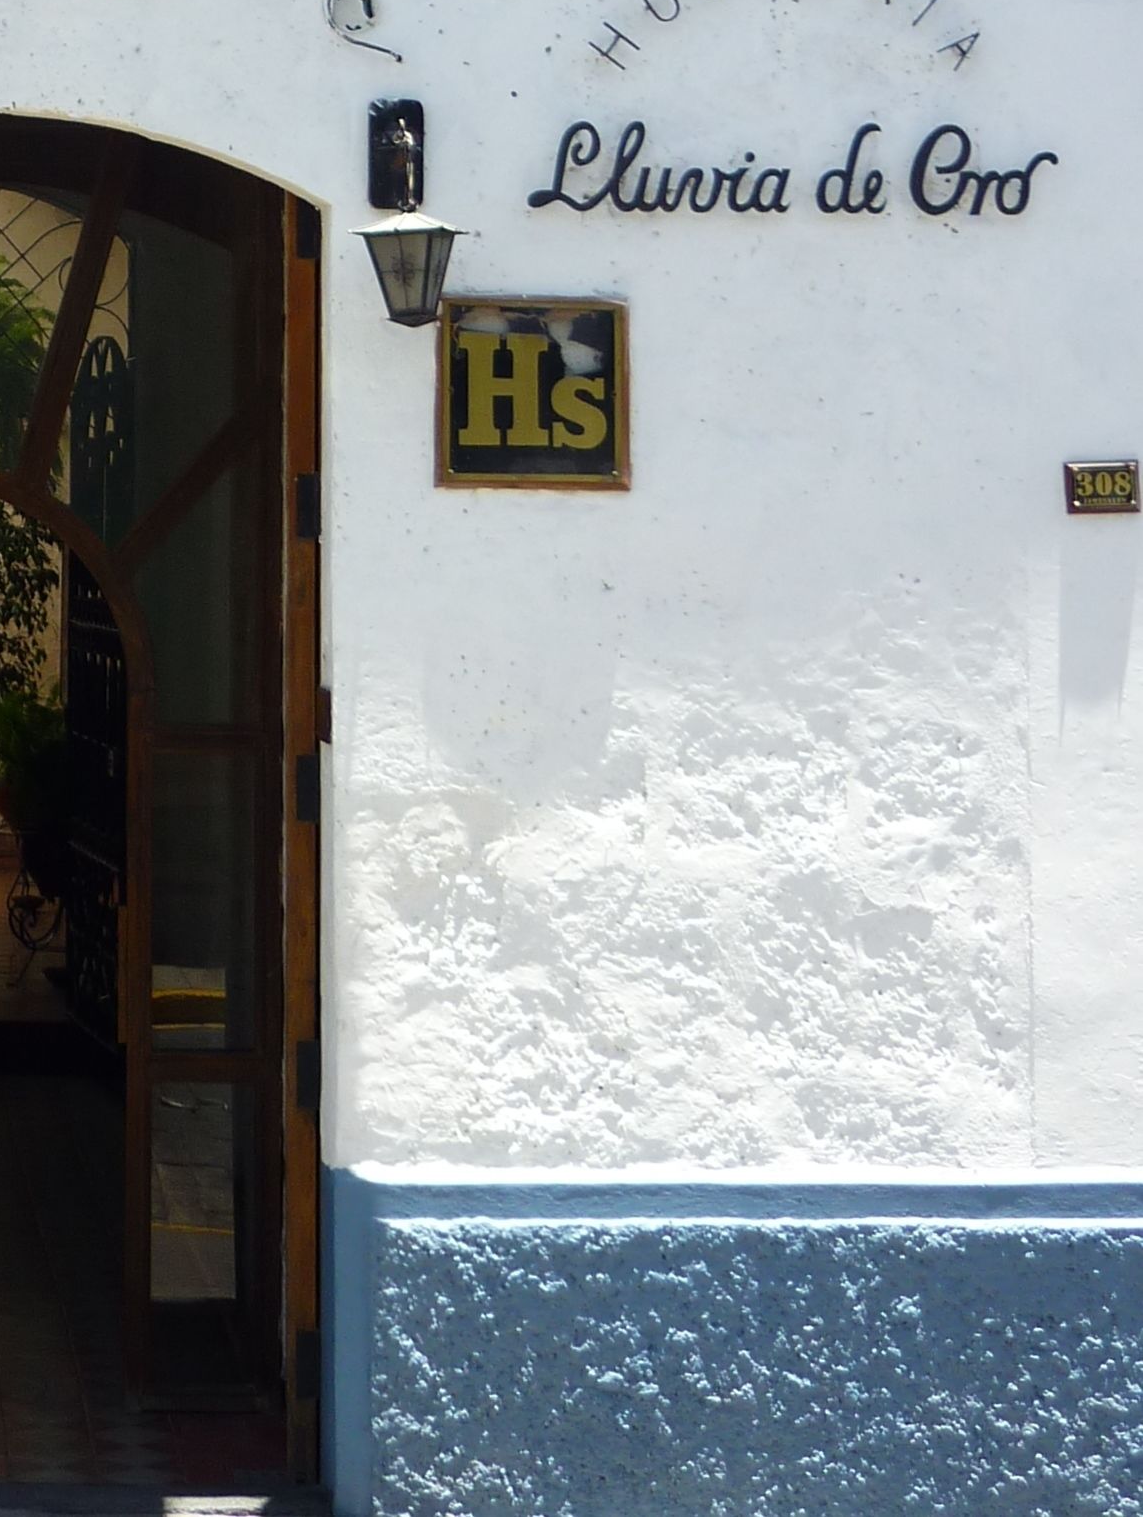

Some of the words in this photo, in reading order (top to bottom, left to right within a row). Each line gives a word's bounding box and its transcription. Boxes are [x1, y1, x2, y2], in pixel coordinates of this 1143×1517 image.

[527, 121, 790, 213] Lluvia
[816, 123, 887, 213] de
[910, 124, 1058, 215] Oro
[459, 333, 607, 449] Hs
[1076, 471, 1131, 496] 308
